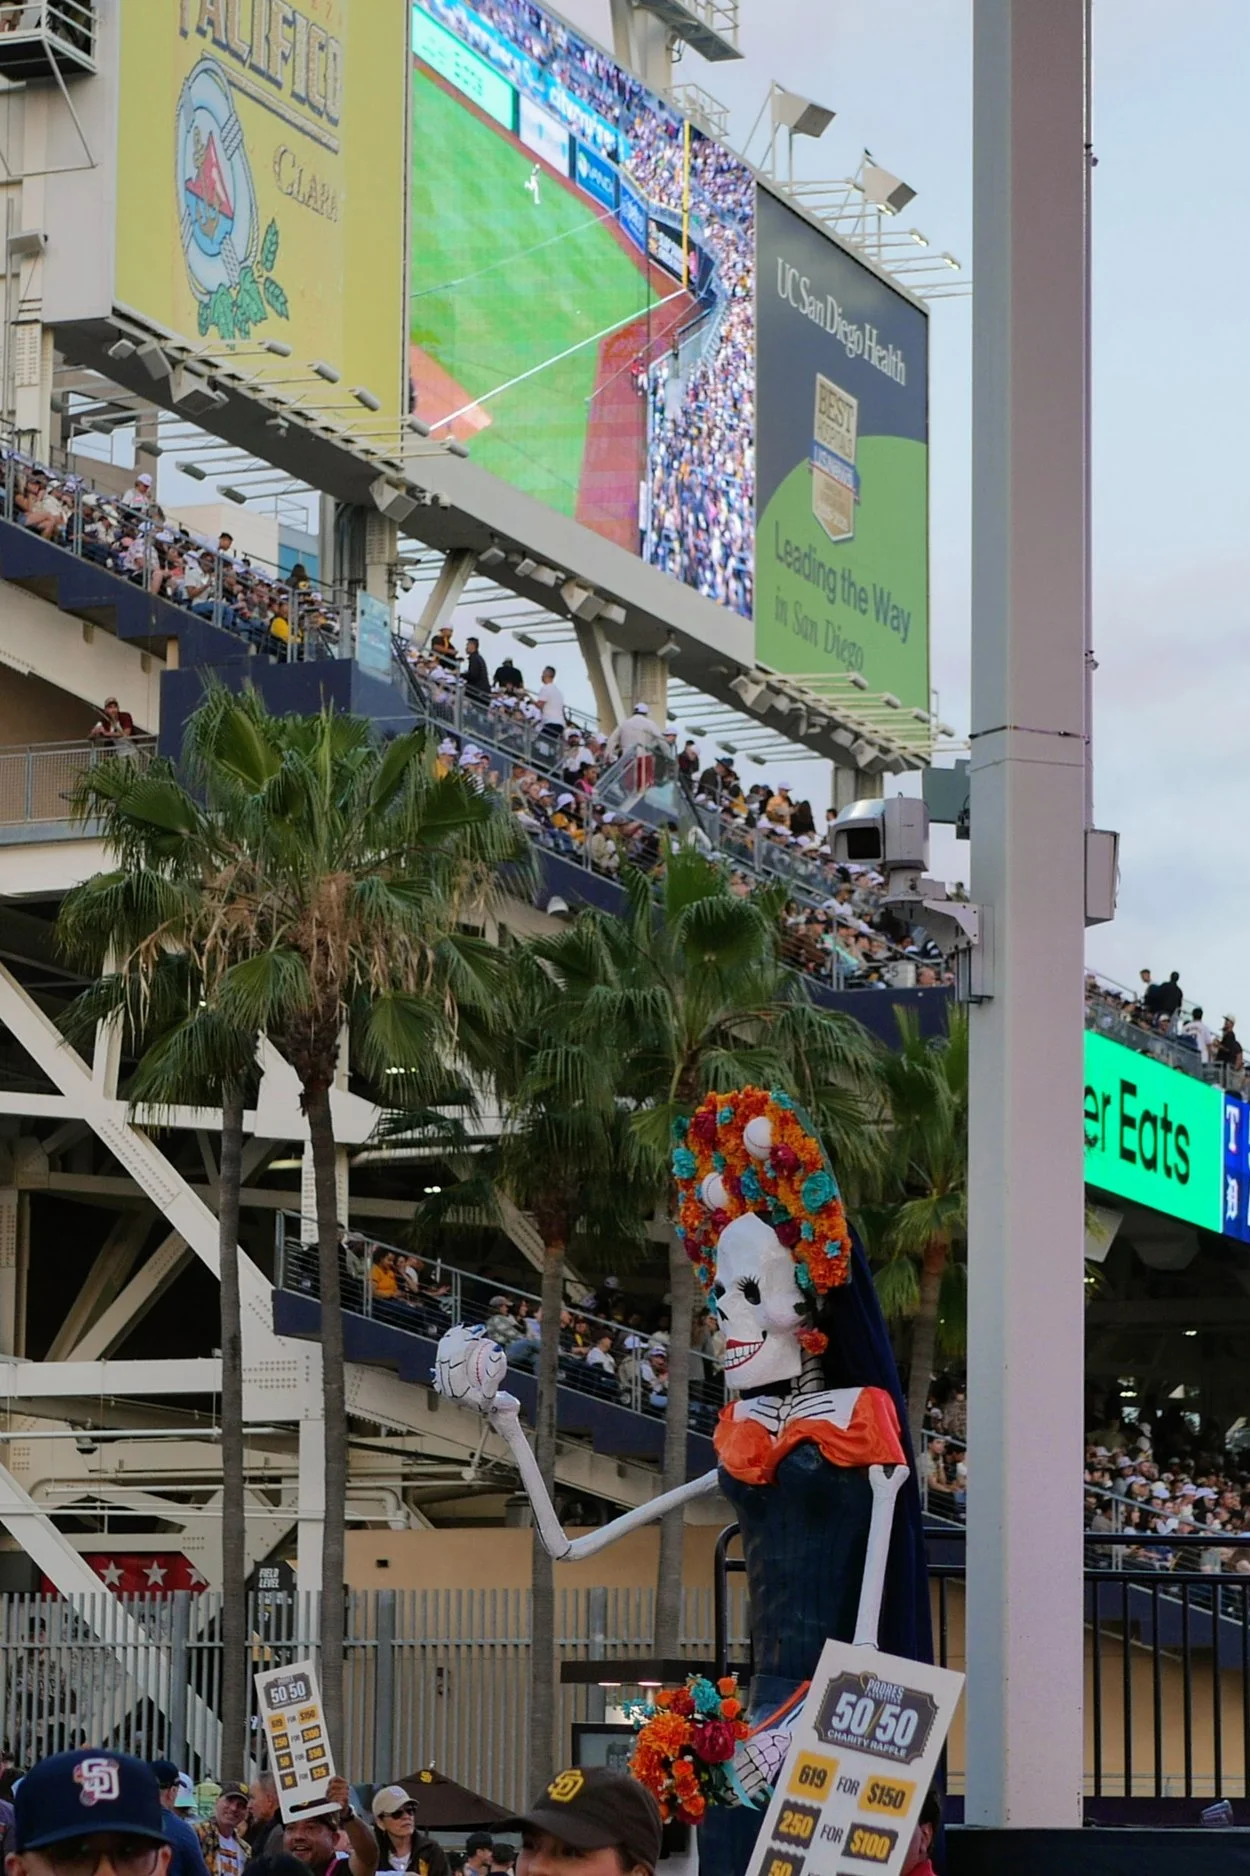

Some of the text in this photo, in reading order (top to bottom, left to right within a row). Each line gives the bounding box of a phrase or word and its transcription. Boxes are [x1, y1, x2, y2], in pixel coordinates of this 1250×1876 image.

[777, 257, 906, 386] UC San Diego Health
[775, 521, 912, 643] Leading the Way
[775, 586, 864, 672] in San Diego
[1120, 1079, 1190, 1185] Eats
[258, 1568, 279, 1578] FIELD
[258, 1578, 279, 1588] LEVEL
[827, 1729, 907, 1758] CHARITY RAFFLE
[798, 1764, 906, 1810] 619 FOR $150
[778, 1810, 891, 1861] 250 FOR $100
